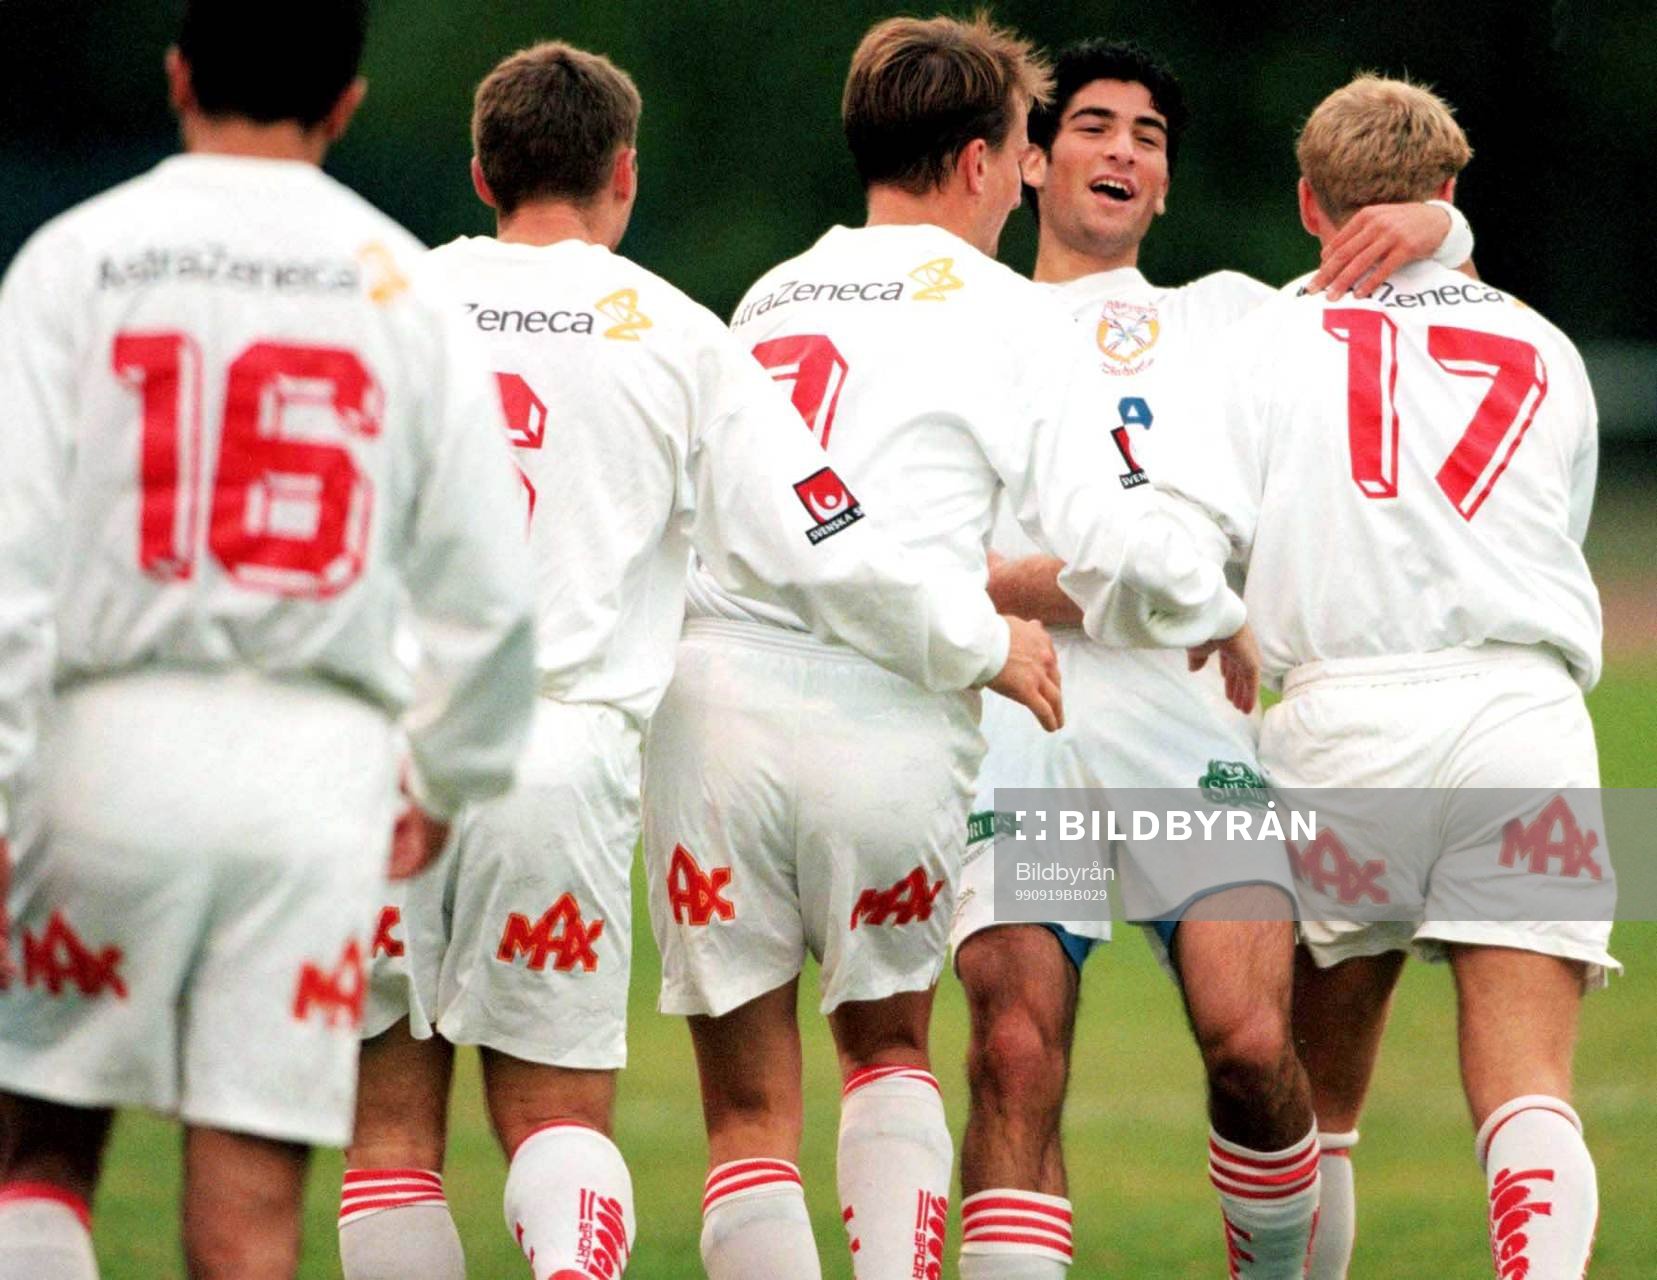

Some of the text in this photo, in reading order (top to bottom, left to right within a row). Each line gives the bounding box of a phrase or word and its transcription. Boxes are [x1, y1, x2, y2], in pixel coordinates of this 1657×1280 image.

[463, 302, 595, 335] eneca
[1323, 308, 1548, 522] 17
[110, 332, 386, 600] 16
[809, 512, 855, 541] SVENSKA
[1498, 795, 1603, 881] MAX
[667, 843, 736, 927] AX
[496, 892, 605, 972] MAX
[291, 936, 367, 1031] MA
[576, 1222, 593, 1270] SPORT
[911, 1231, 927, 1280] SPOR
